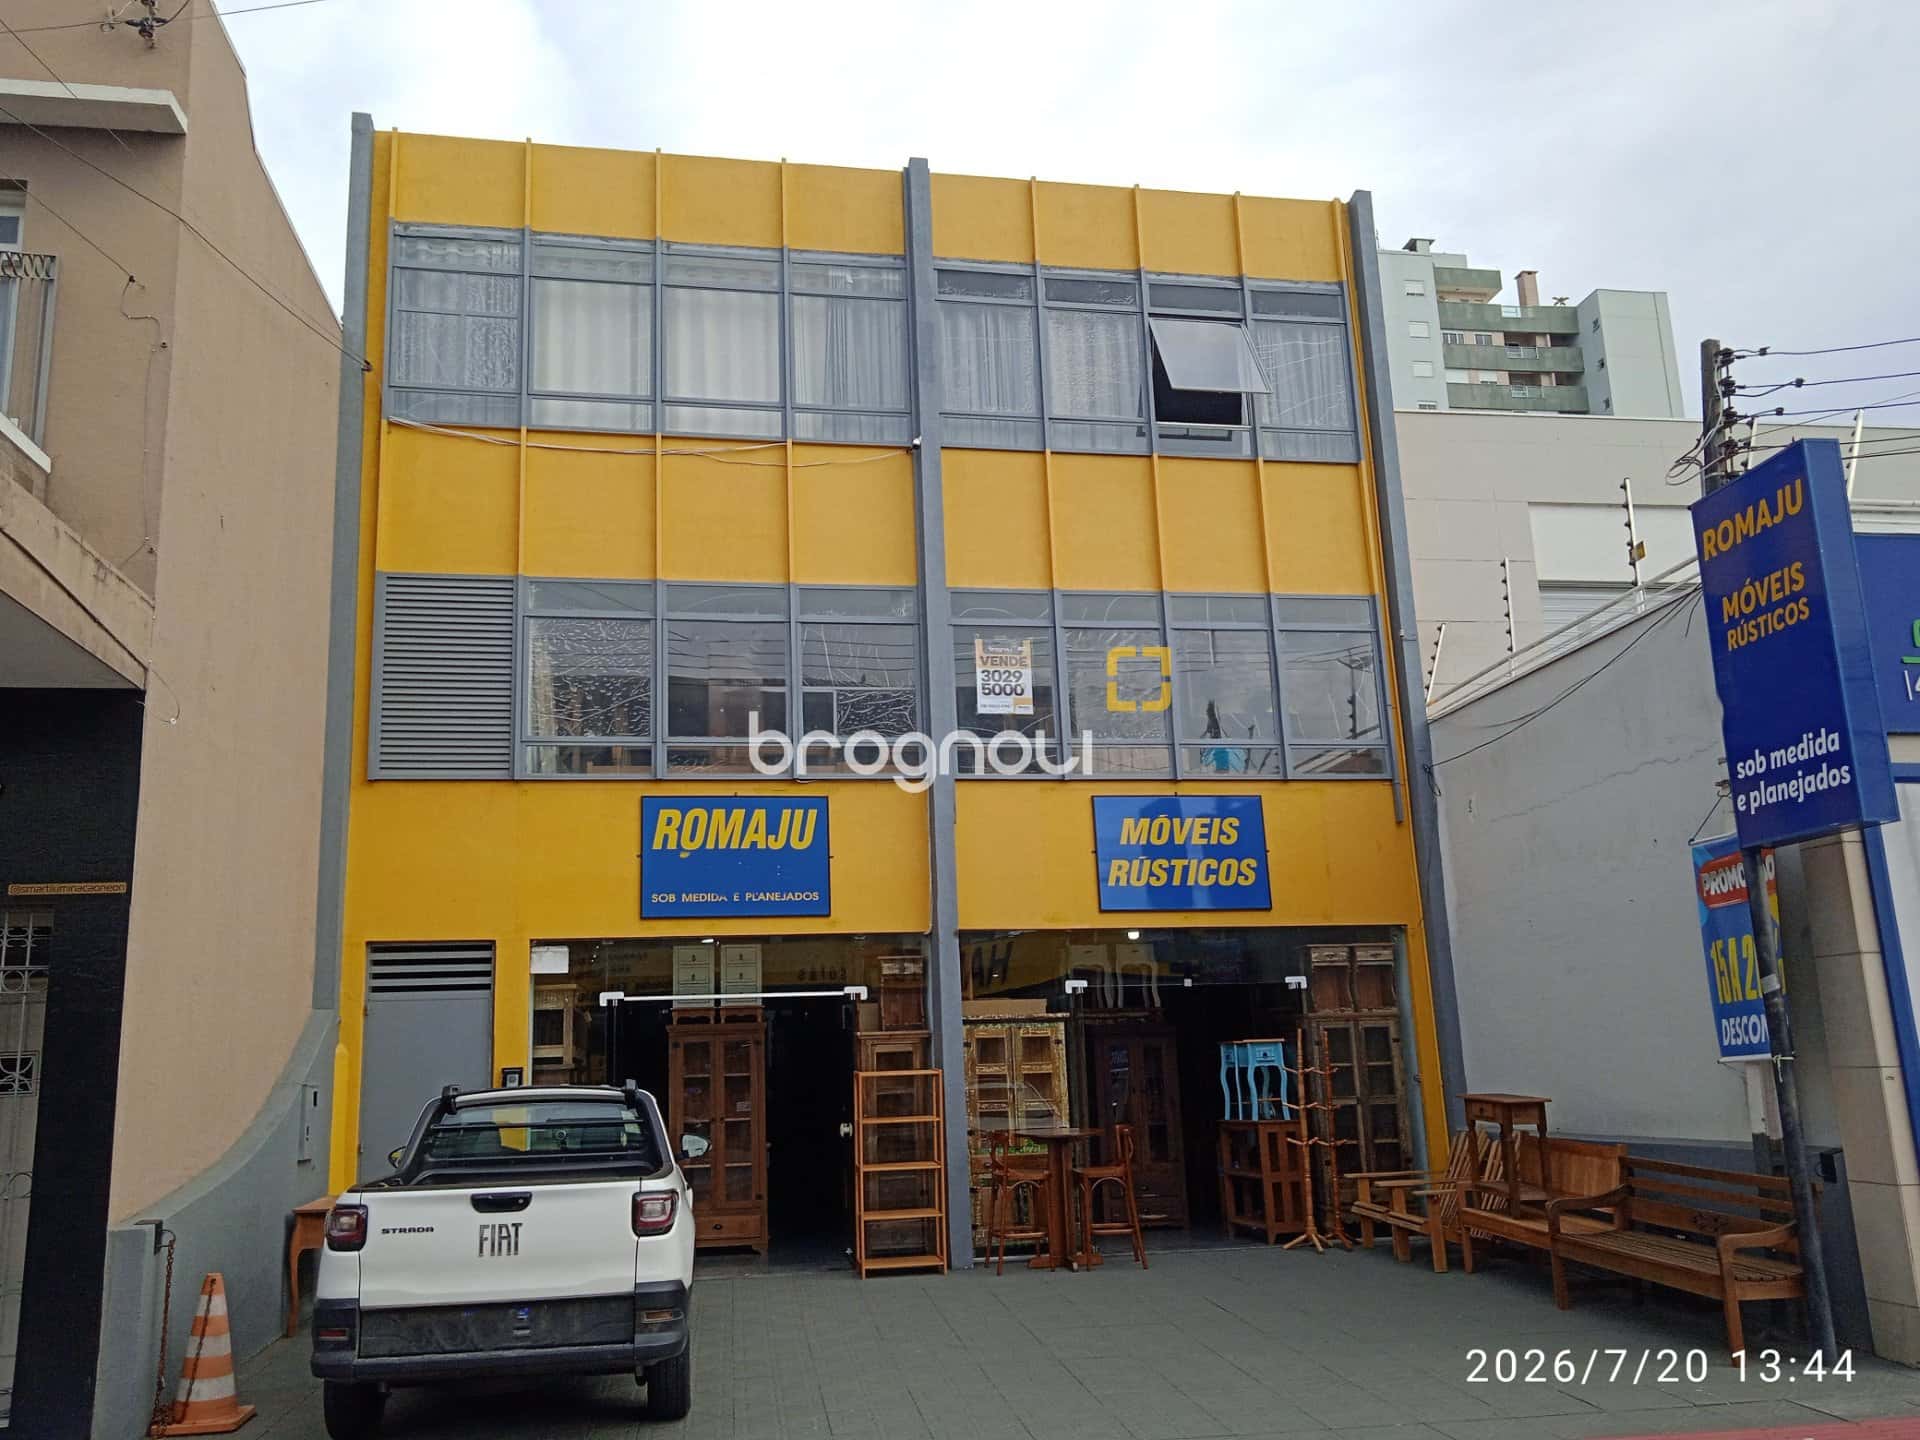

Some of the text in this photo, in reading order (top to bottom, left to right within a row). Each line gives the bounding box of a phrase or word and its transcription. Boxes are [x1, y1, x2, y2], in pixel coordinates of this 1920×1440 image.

[1702, 479, 1803, 561] ROMAJU
[1721, 561, 1805, 624] MÓVEIS
[1727, 597, 1810, 651] RÚSTICOS
[980, 656, 1028, 667] VENDE
[981, 670, 1023, 682] 3029
[981, 683, 1024, 696] 5000
[1736, 727, 1840, 779] sob medida
[1736, 762, 1851, 815] e planejados
[652, 808, 818, 850] ROMAJU
[1119, 814, 1240, 845] MÓVEIS
[1107, 856, 1258, 887] RÚSTICOS
[651, 893, 676, 903] SOB
[733, 893, 740, 901] E
[745, 891, 820, 902] PLANEJADOS
[381, 1226, 435, 1235] STRADA
[478, 1222, 523, 1257] FIAT
